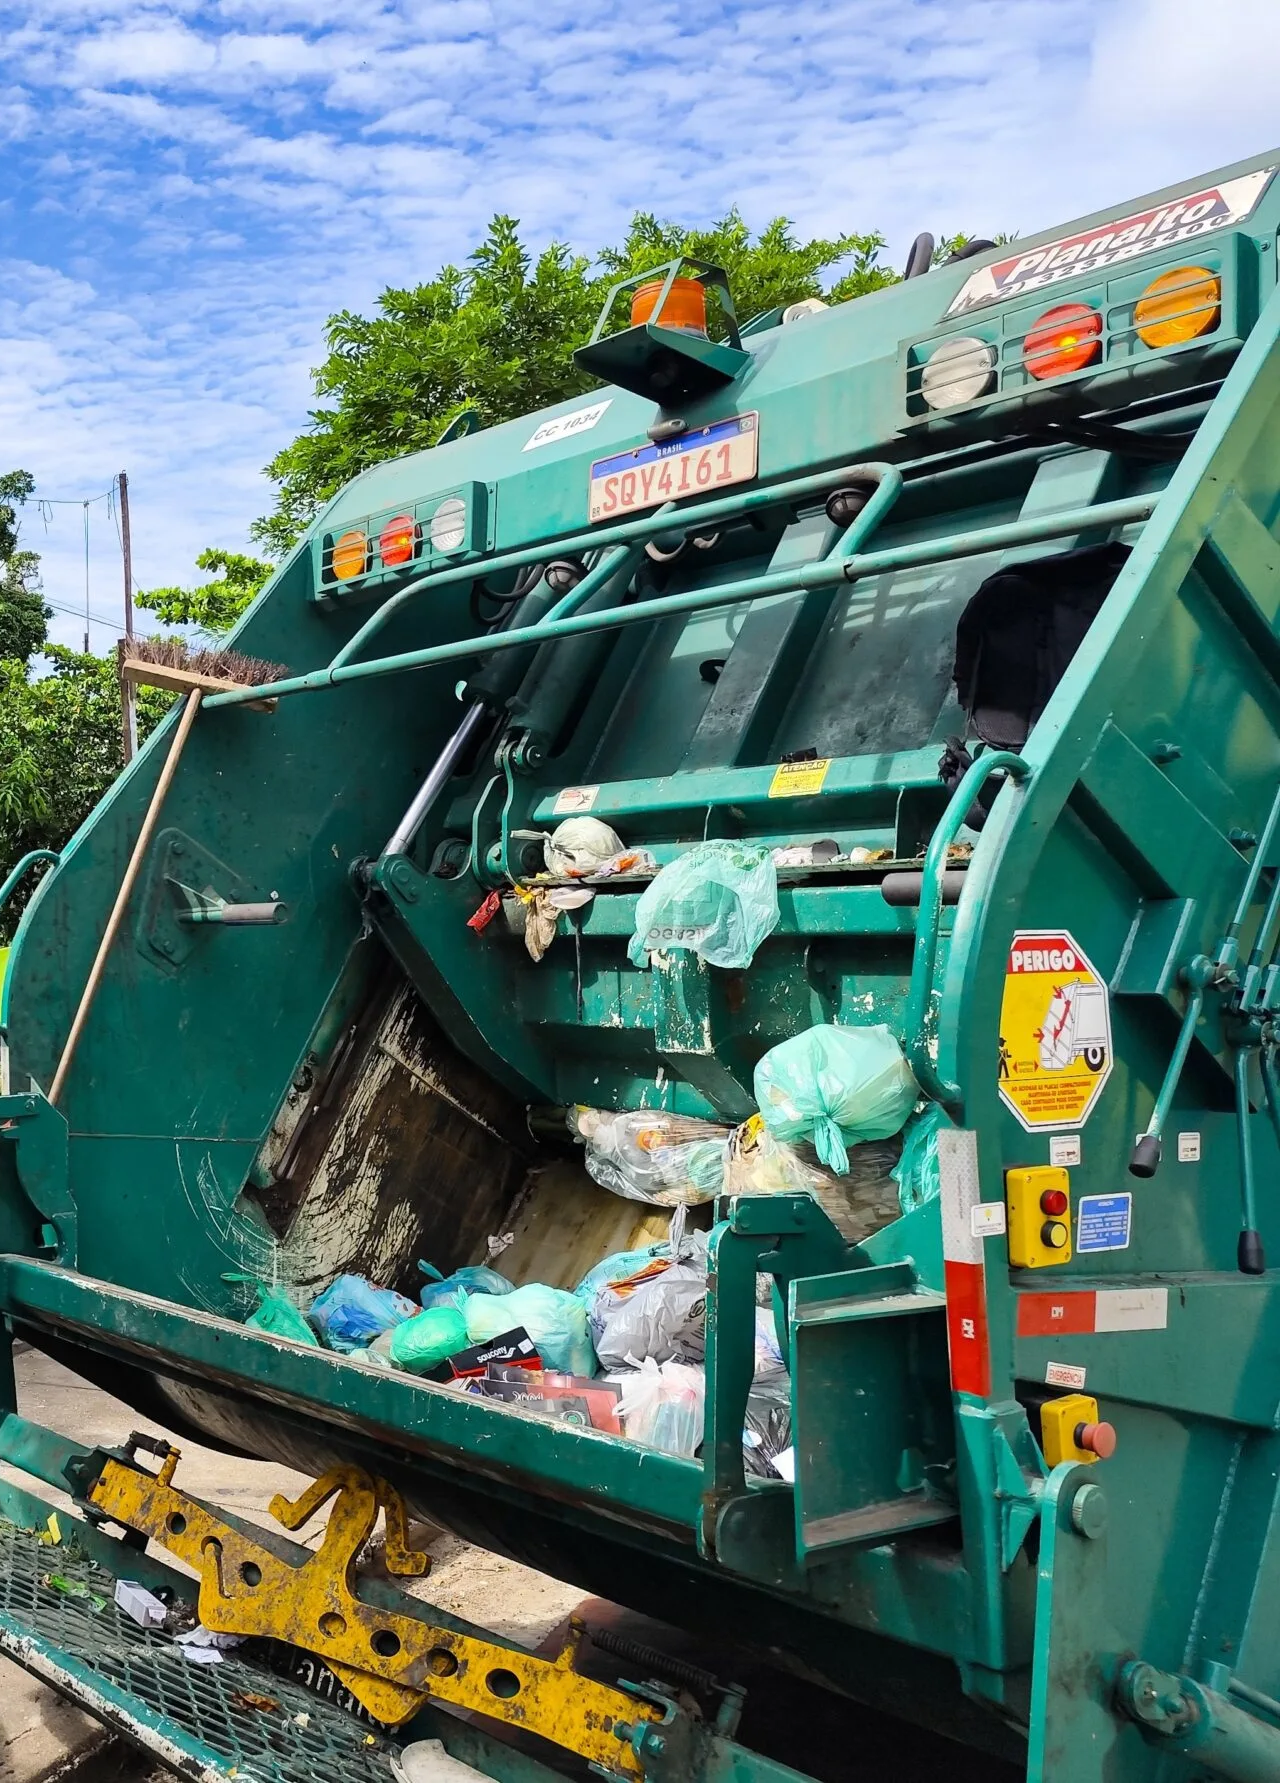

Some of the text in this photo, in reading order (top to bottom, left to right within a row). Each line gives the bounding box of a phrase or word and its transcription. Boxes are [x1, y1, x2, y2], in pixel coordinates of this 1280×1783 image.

[1002, 198, 1217, 286] Planalto
[563, 409, 602, 431] 1034
[656, 443, 684, 458] BRASIL
[603, 443, 732, 512] SQY4I61
[591, 506, 601, 517] BR
[1011, 950, 1075, 972] PERIGO
[476, 1344, 508, 1364] saucony
